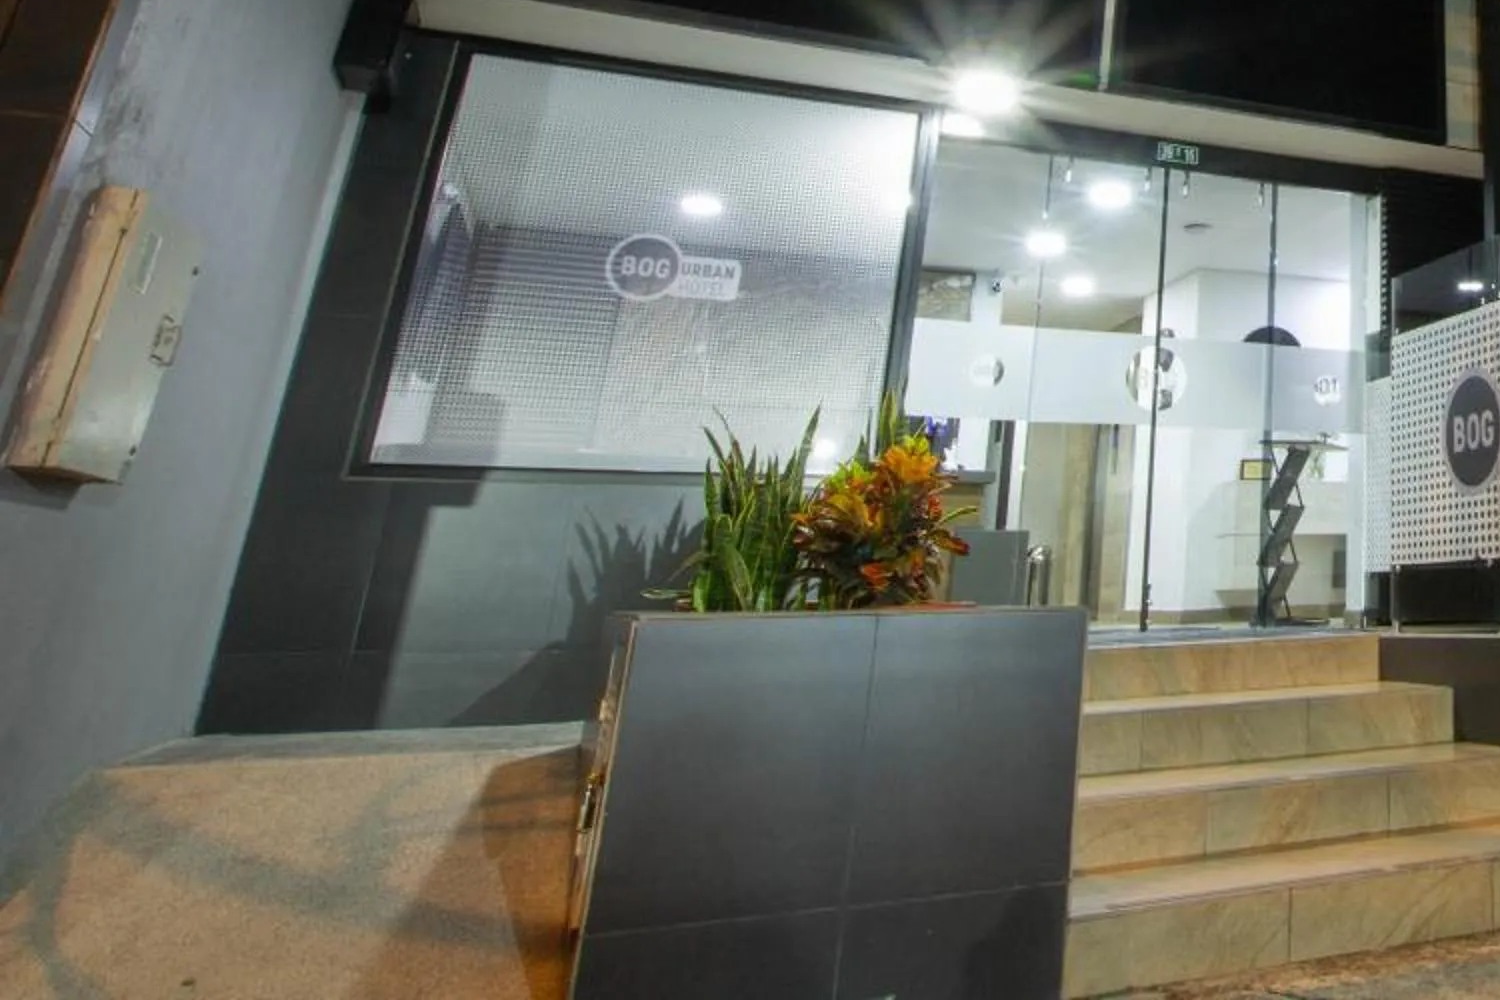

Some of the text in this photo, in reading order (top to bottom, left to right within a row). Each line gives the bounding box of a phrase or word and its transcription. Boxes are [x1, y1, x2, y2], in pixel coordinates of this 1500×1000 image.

[621, 255, 671, 278] BOG
[681, 262, 736, 279] URBAN
[1453, 409, 1495, 453] BOG
